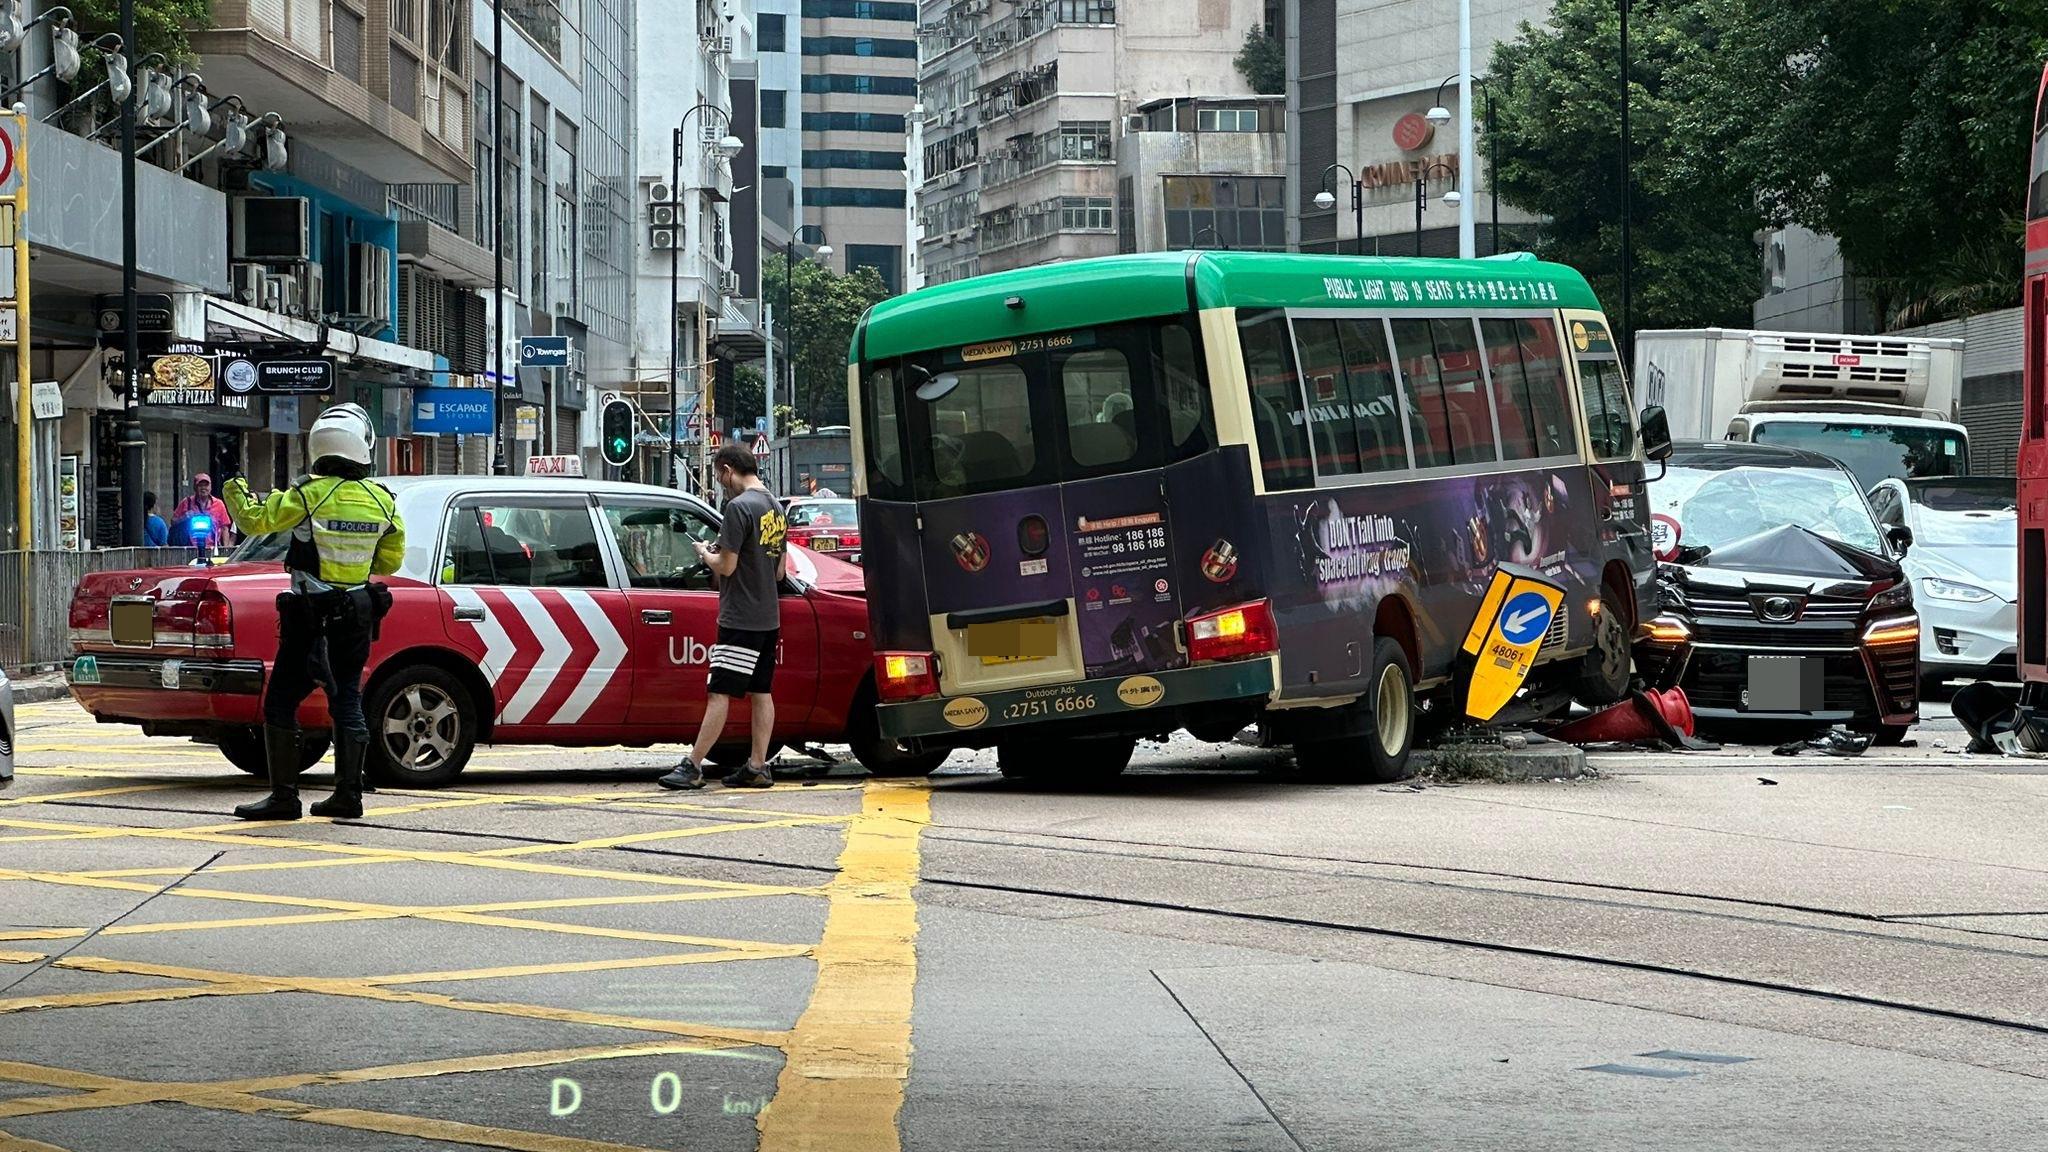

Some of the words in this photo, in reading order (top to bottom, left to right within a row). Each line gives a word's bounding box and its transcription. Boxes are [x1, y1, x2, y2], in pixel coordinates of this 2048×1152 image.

[1323, 277, 1357, 299] PUBLIC
[1359, 279, 1386, 300] LIGHT
[1390, 280, 1409, 301] BUS
[1411, 280, 1423, 301] 19
[1425, 280, 1453, 300] SEATS
[1456, 280, 1558, 300] 公共小型巴士十九座位
[536, 348, 566, 357] Towngas
[963, 347, 987, 357] MEDIA
[987, 343, 1012, 354] SAVVY
[1020, 340, 1044, 351] 2751
[1047, 335, 1073, 347] 6666
[266, 366, 301, 374] BRUNCH
[301, 366, 323, 374] CLUB
[147, 389, 177, 405] MOTHER
[185, 389, 215, 405] PIZZAS
[439, 403, 488, 413] ESCAPADE
[530, 456, 566, 473] TAXI
[341, 522, 371, 532] POLICE
[1126, 530, 1144, 541] 186
[1146, 527, 1164, 538] 186
[1329, 516, 1356, 548] DON'T
[1357, 515, 1374, 545] fall
[1374, 514, 1394, 542] into
[1112, 543, 1125, 554] 98
[1127, 540, 1145, 551] 186
[1147, 537, 1165, 549] 186
[1347, 549, 1360, 577] oil
[1492, 644, 1524, 662] 48061
[83, 662, 88, 673] 4
[1025, 687, 1059, 699] Outdoor
[1060, 686, 1076, 695] Ads
[965, 706, 987, 716] SAVVY
[1010, 700, 1049, 718] 2751
[1055, 695, 1096, 713] 6666
[550, 1078, 582, 1116] D
[652, 1071, 683, 1114] 0
